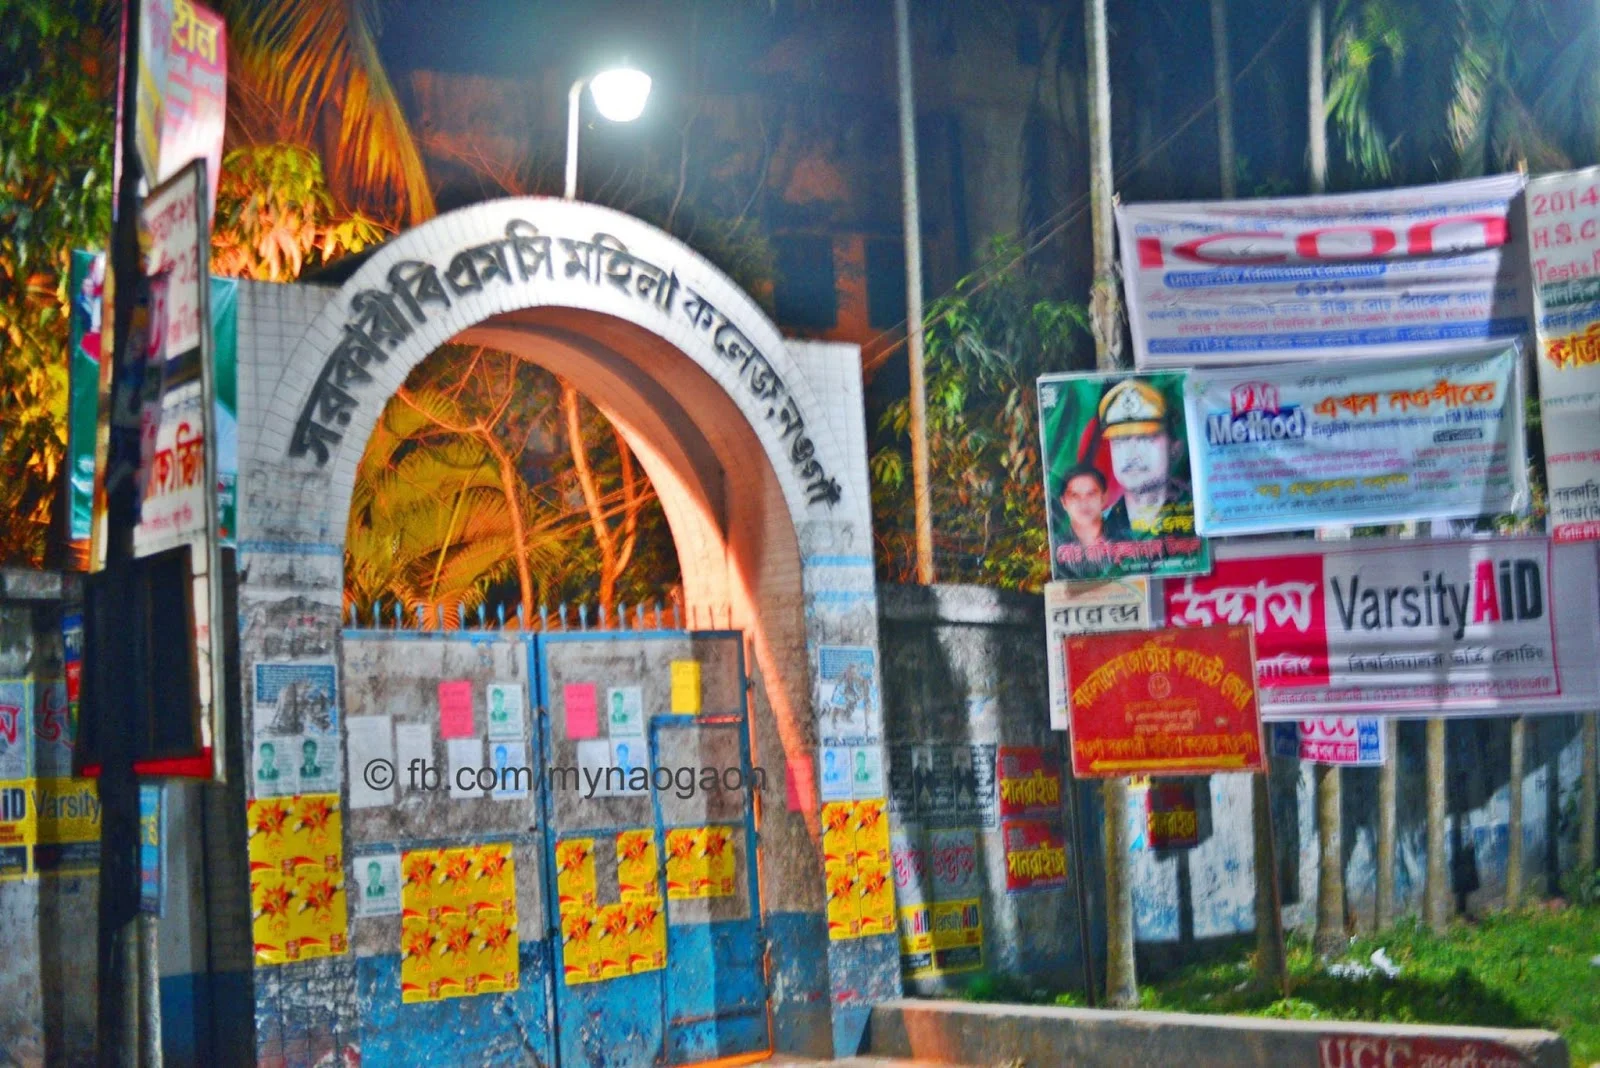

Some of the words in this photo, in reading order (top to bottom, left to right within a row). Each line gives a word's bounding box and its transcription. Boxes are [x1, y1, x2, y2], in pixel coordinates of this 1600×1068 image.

[1533, 185, 1599, 216] 2014
[558, 232, 678, 317] মহিলা
[780, 396, 842, 509] নওগাঁ
[1313, 393, 1378, 417] এখন
[1388, 379, 1497, 412] নওগাঁতে
[1209, 407, 1305, 446] Method
[33, 788, 101, 825] Varsity
[1320, 1036, 1411, 1068] UCC
